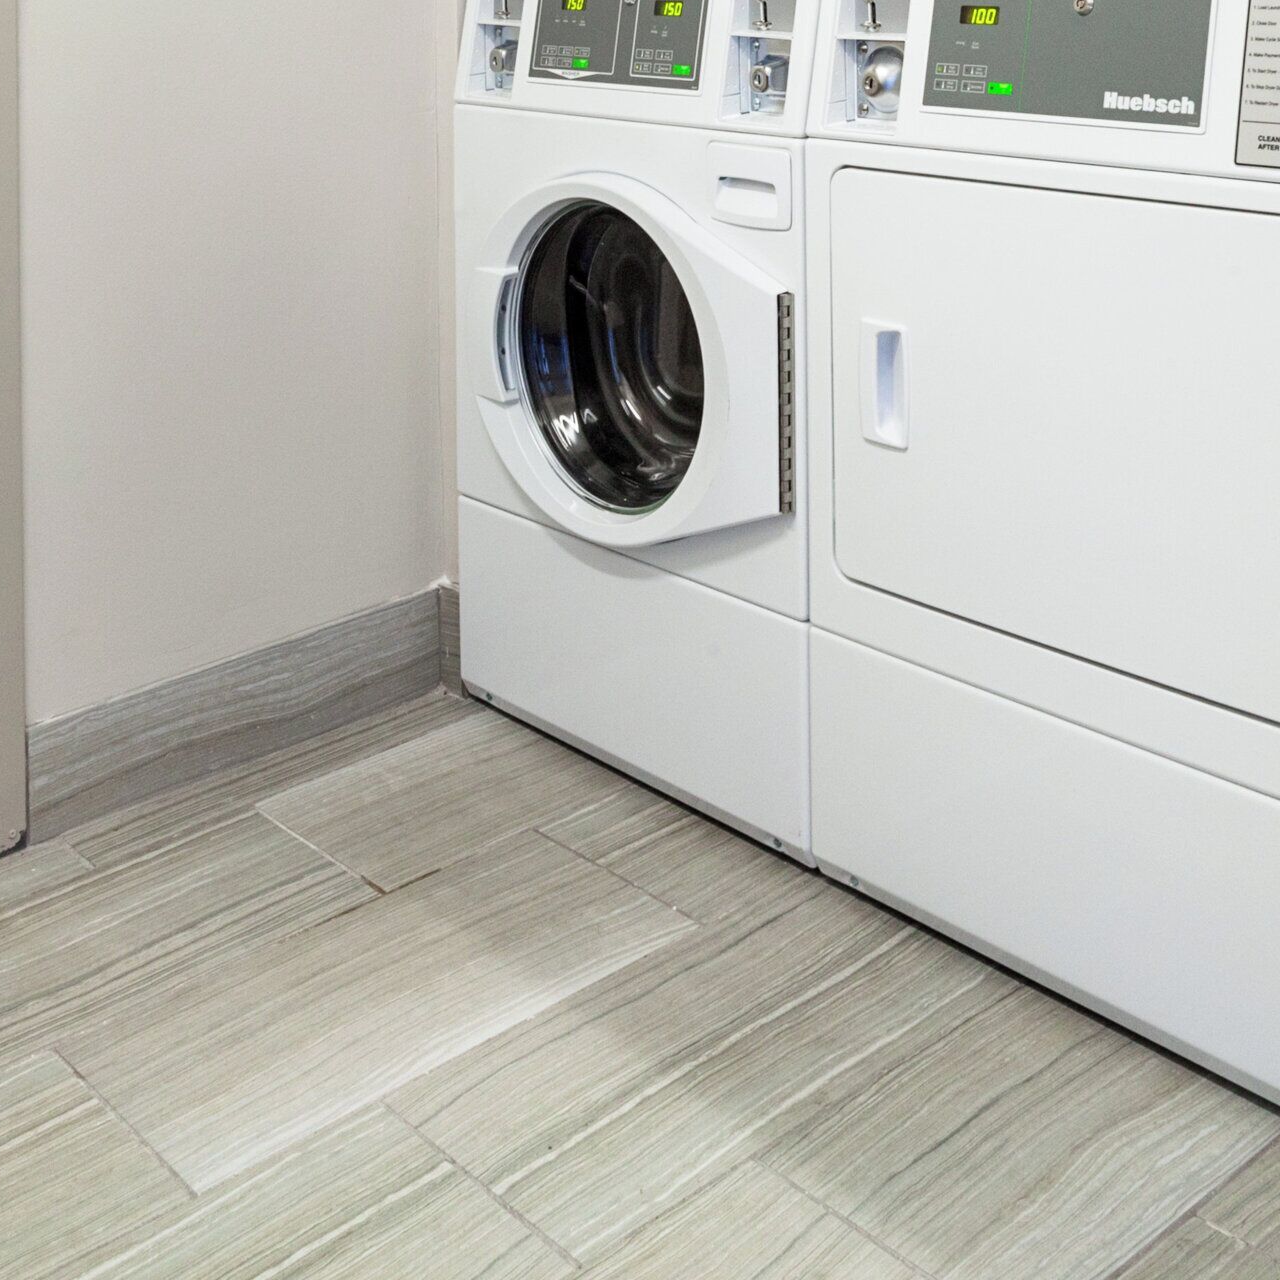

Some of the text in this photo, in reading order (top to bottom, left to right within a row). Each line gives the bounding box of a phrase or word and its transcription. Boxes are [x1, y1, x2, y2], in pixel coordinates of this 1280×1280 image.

[663, 3, 682, 15] 150
[971, 9, 996, 24] 100
[1103, 91, 1194, 114] Huebsch
